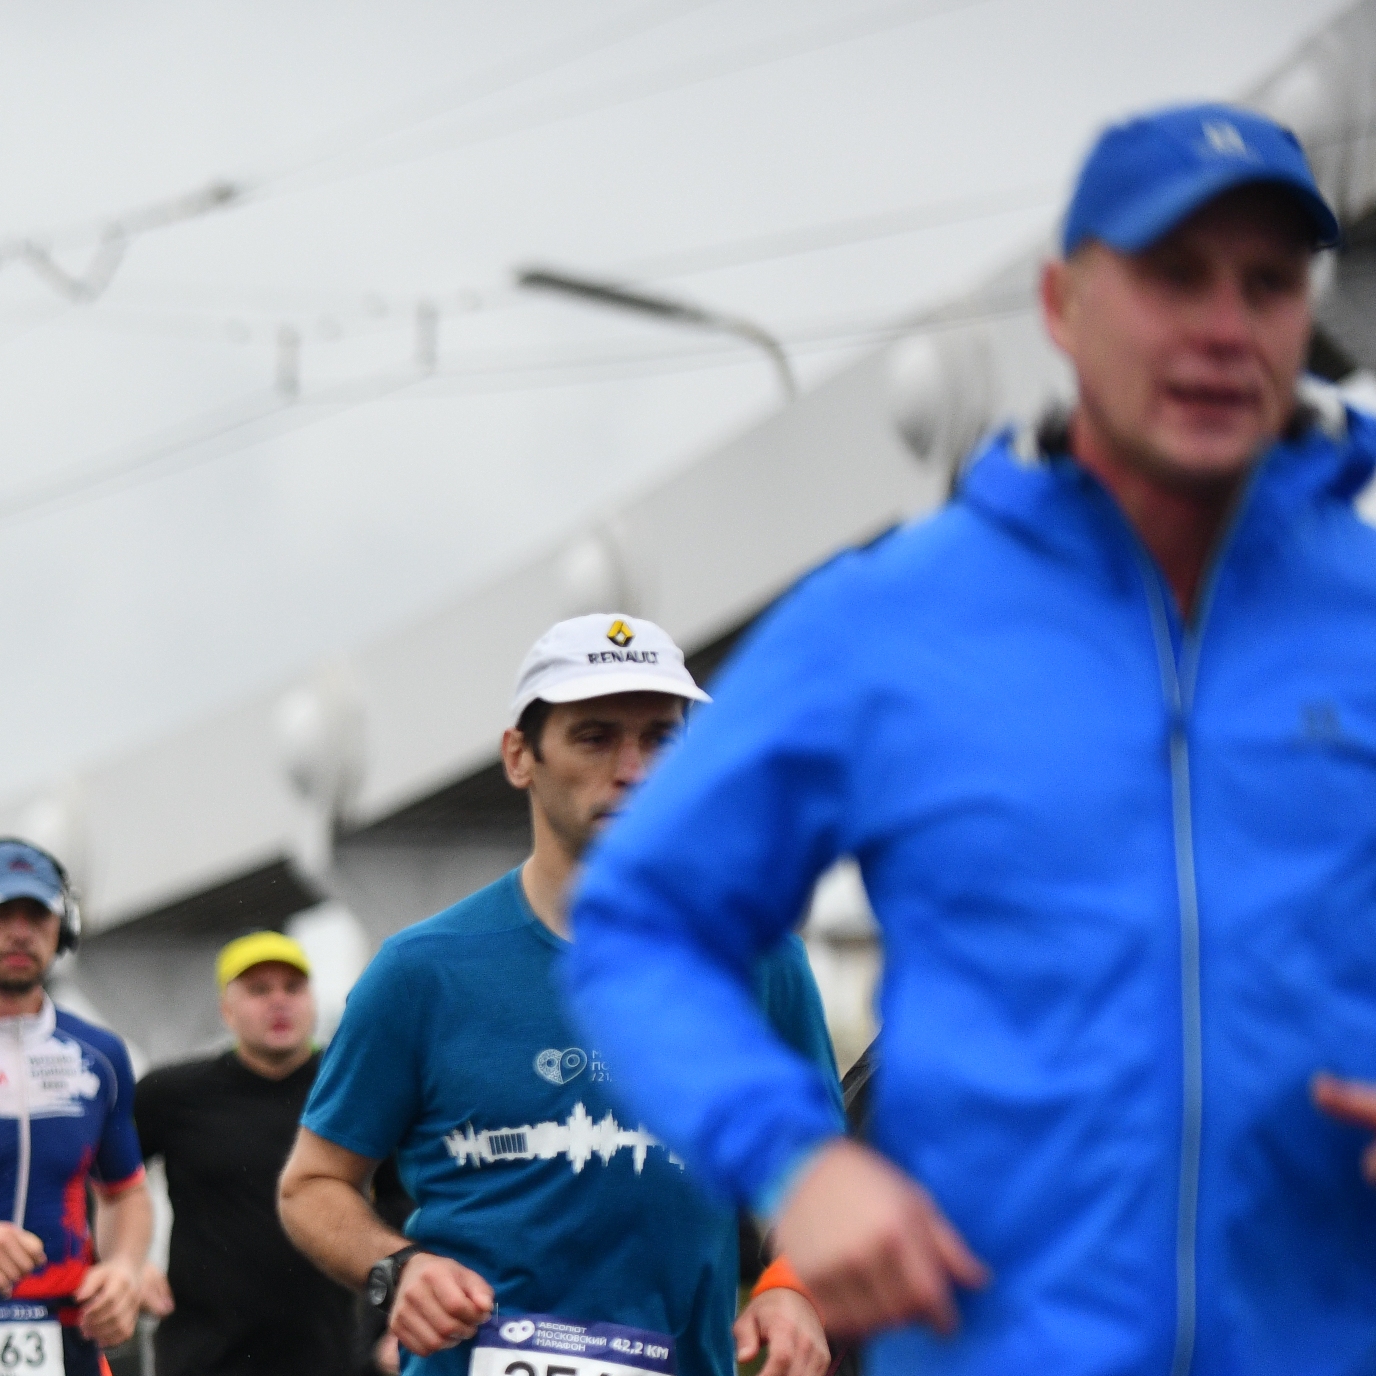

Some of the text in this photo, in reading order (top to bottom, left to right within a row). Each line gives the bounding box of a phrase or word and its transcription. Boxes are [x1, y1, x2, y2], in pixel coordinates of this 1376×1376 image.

[588, 650, 659, 665] RENAULT
[539, 1321, 588, 1334] АБСОЛЮТ
[535, 1338, 587, 1352] МАРАФОН
[537, 1329, 608, 1347] МОСКОВСКИЙ
[611, 1337, 645, 1355] 42,2
